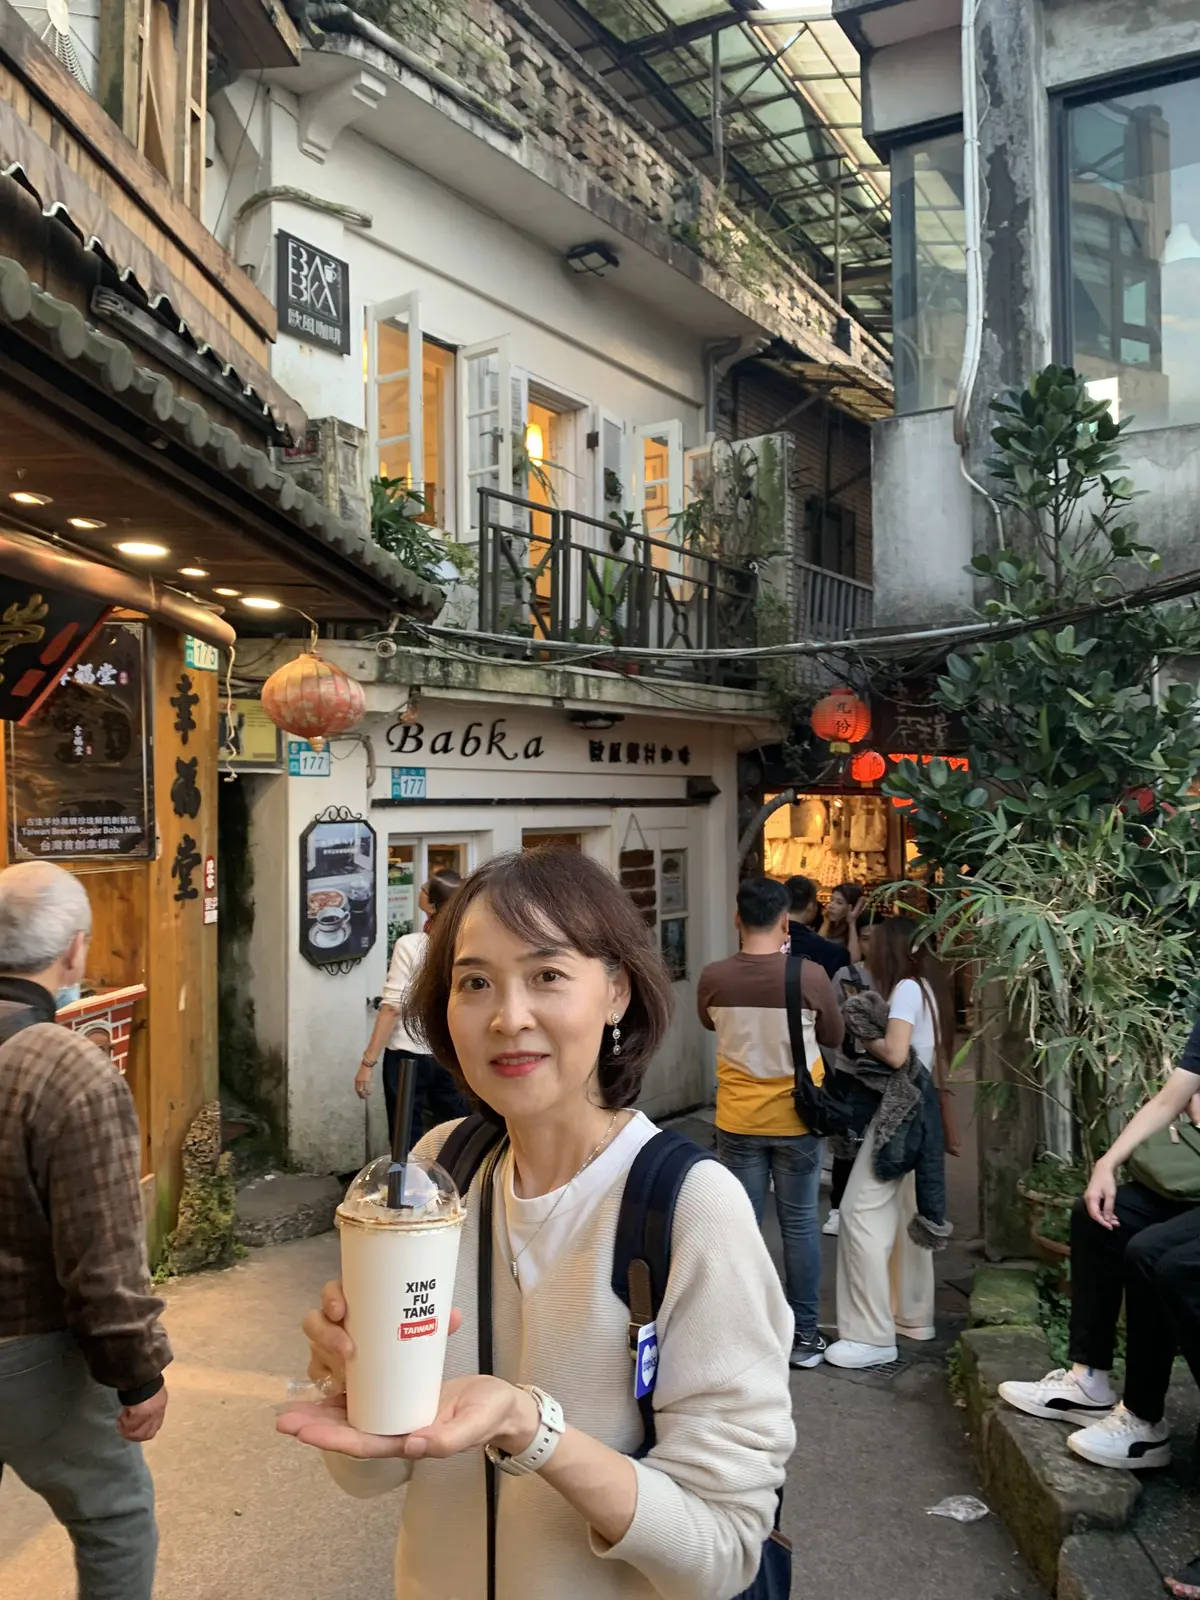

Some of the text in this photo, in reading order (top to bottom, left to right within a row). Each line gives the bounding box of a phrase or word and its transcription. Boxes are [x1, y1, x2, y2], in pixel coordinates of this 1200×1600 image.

[288, 309, 341, 345] 歐風咖啡
[197, 644, 215, 665] 175
[835, 702, 852, 733] 九份
[385, 718, 545, 761] Babka
[302, 755, 324, 770] 177
[170, 672, 202, 902] 幸福堂
[403, 778, 423, 795] 177
[21, 825, 142, 837] Taiwan Brown Sugar Boba Milk
[405, 1278, 436, 1293] XING
[413, 1293, 429, 1306] FU
[403, 1304, 435, 1319] TANG
[403, 1322, 435, 1335] TAIWAN
